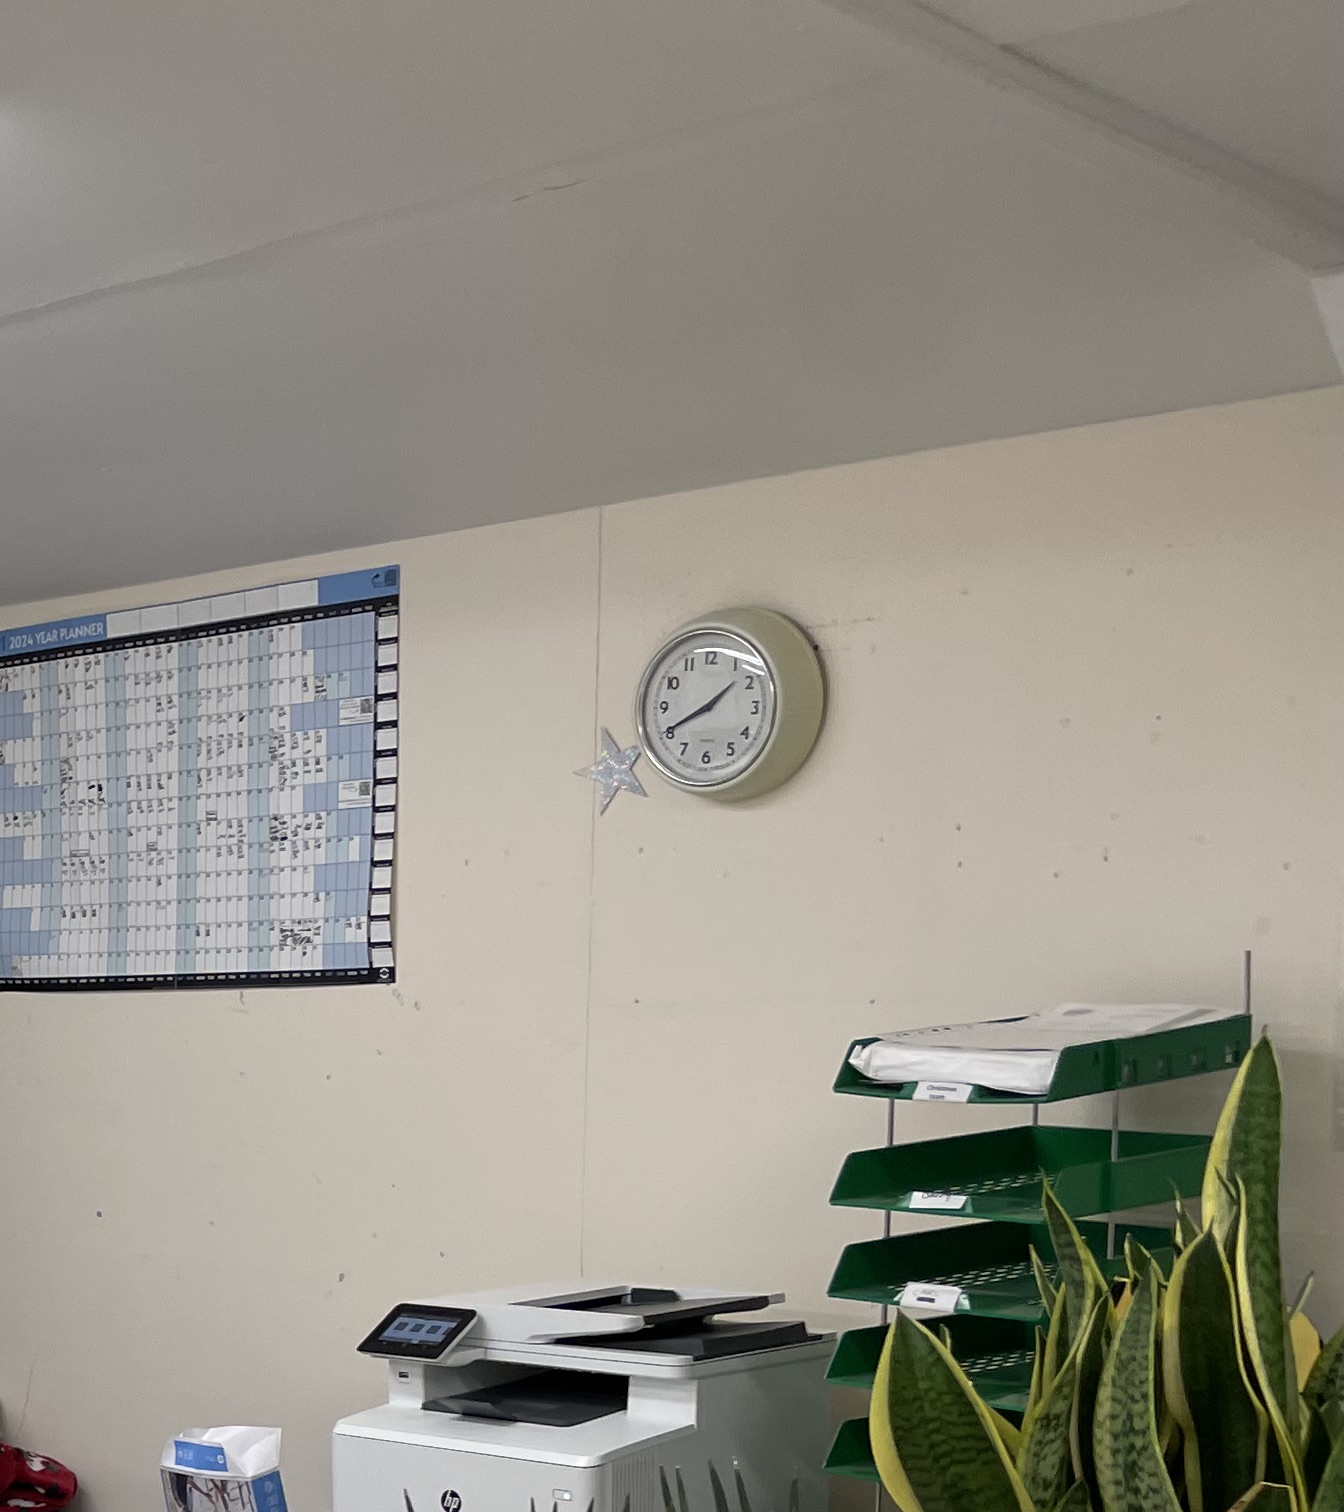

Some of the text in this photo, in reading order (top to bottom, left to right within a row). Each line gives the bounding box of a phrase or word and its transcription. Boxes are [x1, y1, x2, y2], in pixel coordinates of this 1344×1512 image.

[9, 635, 33, 650] 2024
[35, 630, 58, 644] YEAR
[60, 622, 104, 641] PLANNER
[684, 657, 695, 672] 11
[704, 651, 718, 666] 12
[666, 676, 680, 690] 10
[744, 675, 755, 690] 2
[659, 701, 669, 714] 9
[750, 700, 760, 715] 3
[665, 726, 675, 740] 8
[739, 726, 750, 740] 4
[679, 742, 689, 756] 7
[726, 742, 736, 757] 5
[701, 750, 711, 765] 6
